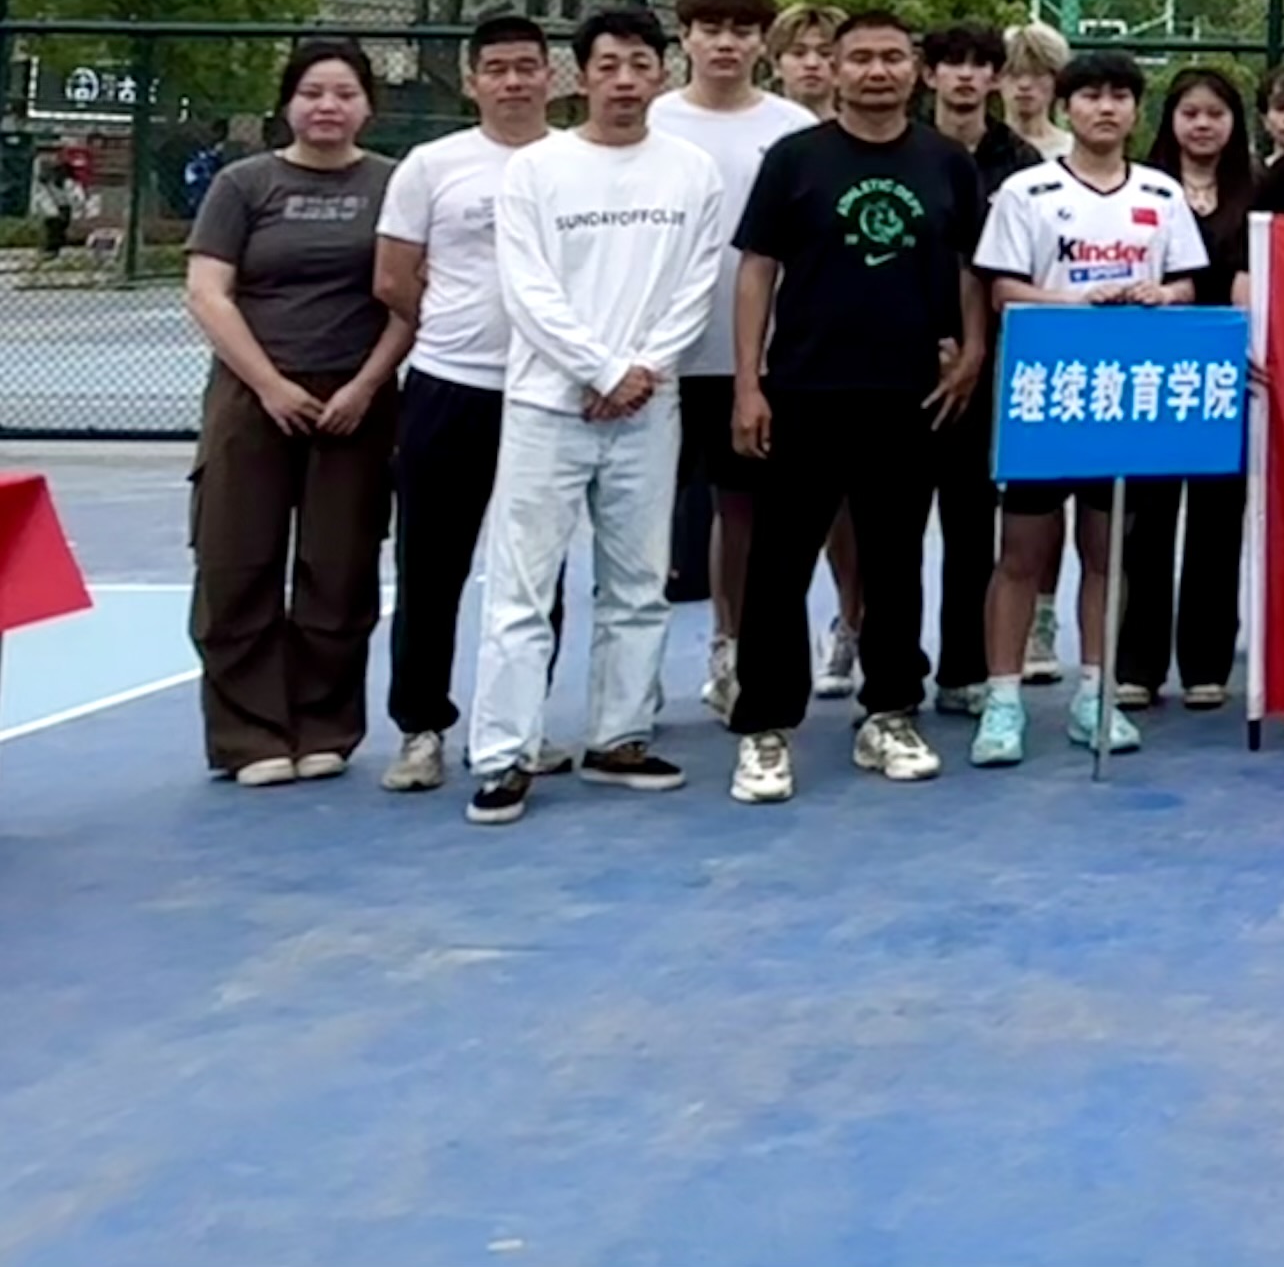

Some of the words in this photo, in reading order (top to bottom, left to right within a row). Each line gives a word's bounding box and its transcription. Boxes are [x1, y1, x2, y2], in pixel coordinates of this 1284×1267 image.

[1058, 235, 1148, 262] Kinder
[1009, 359, 1239, 423] 继续教育学院
